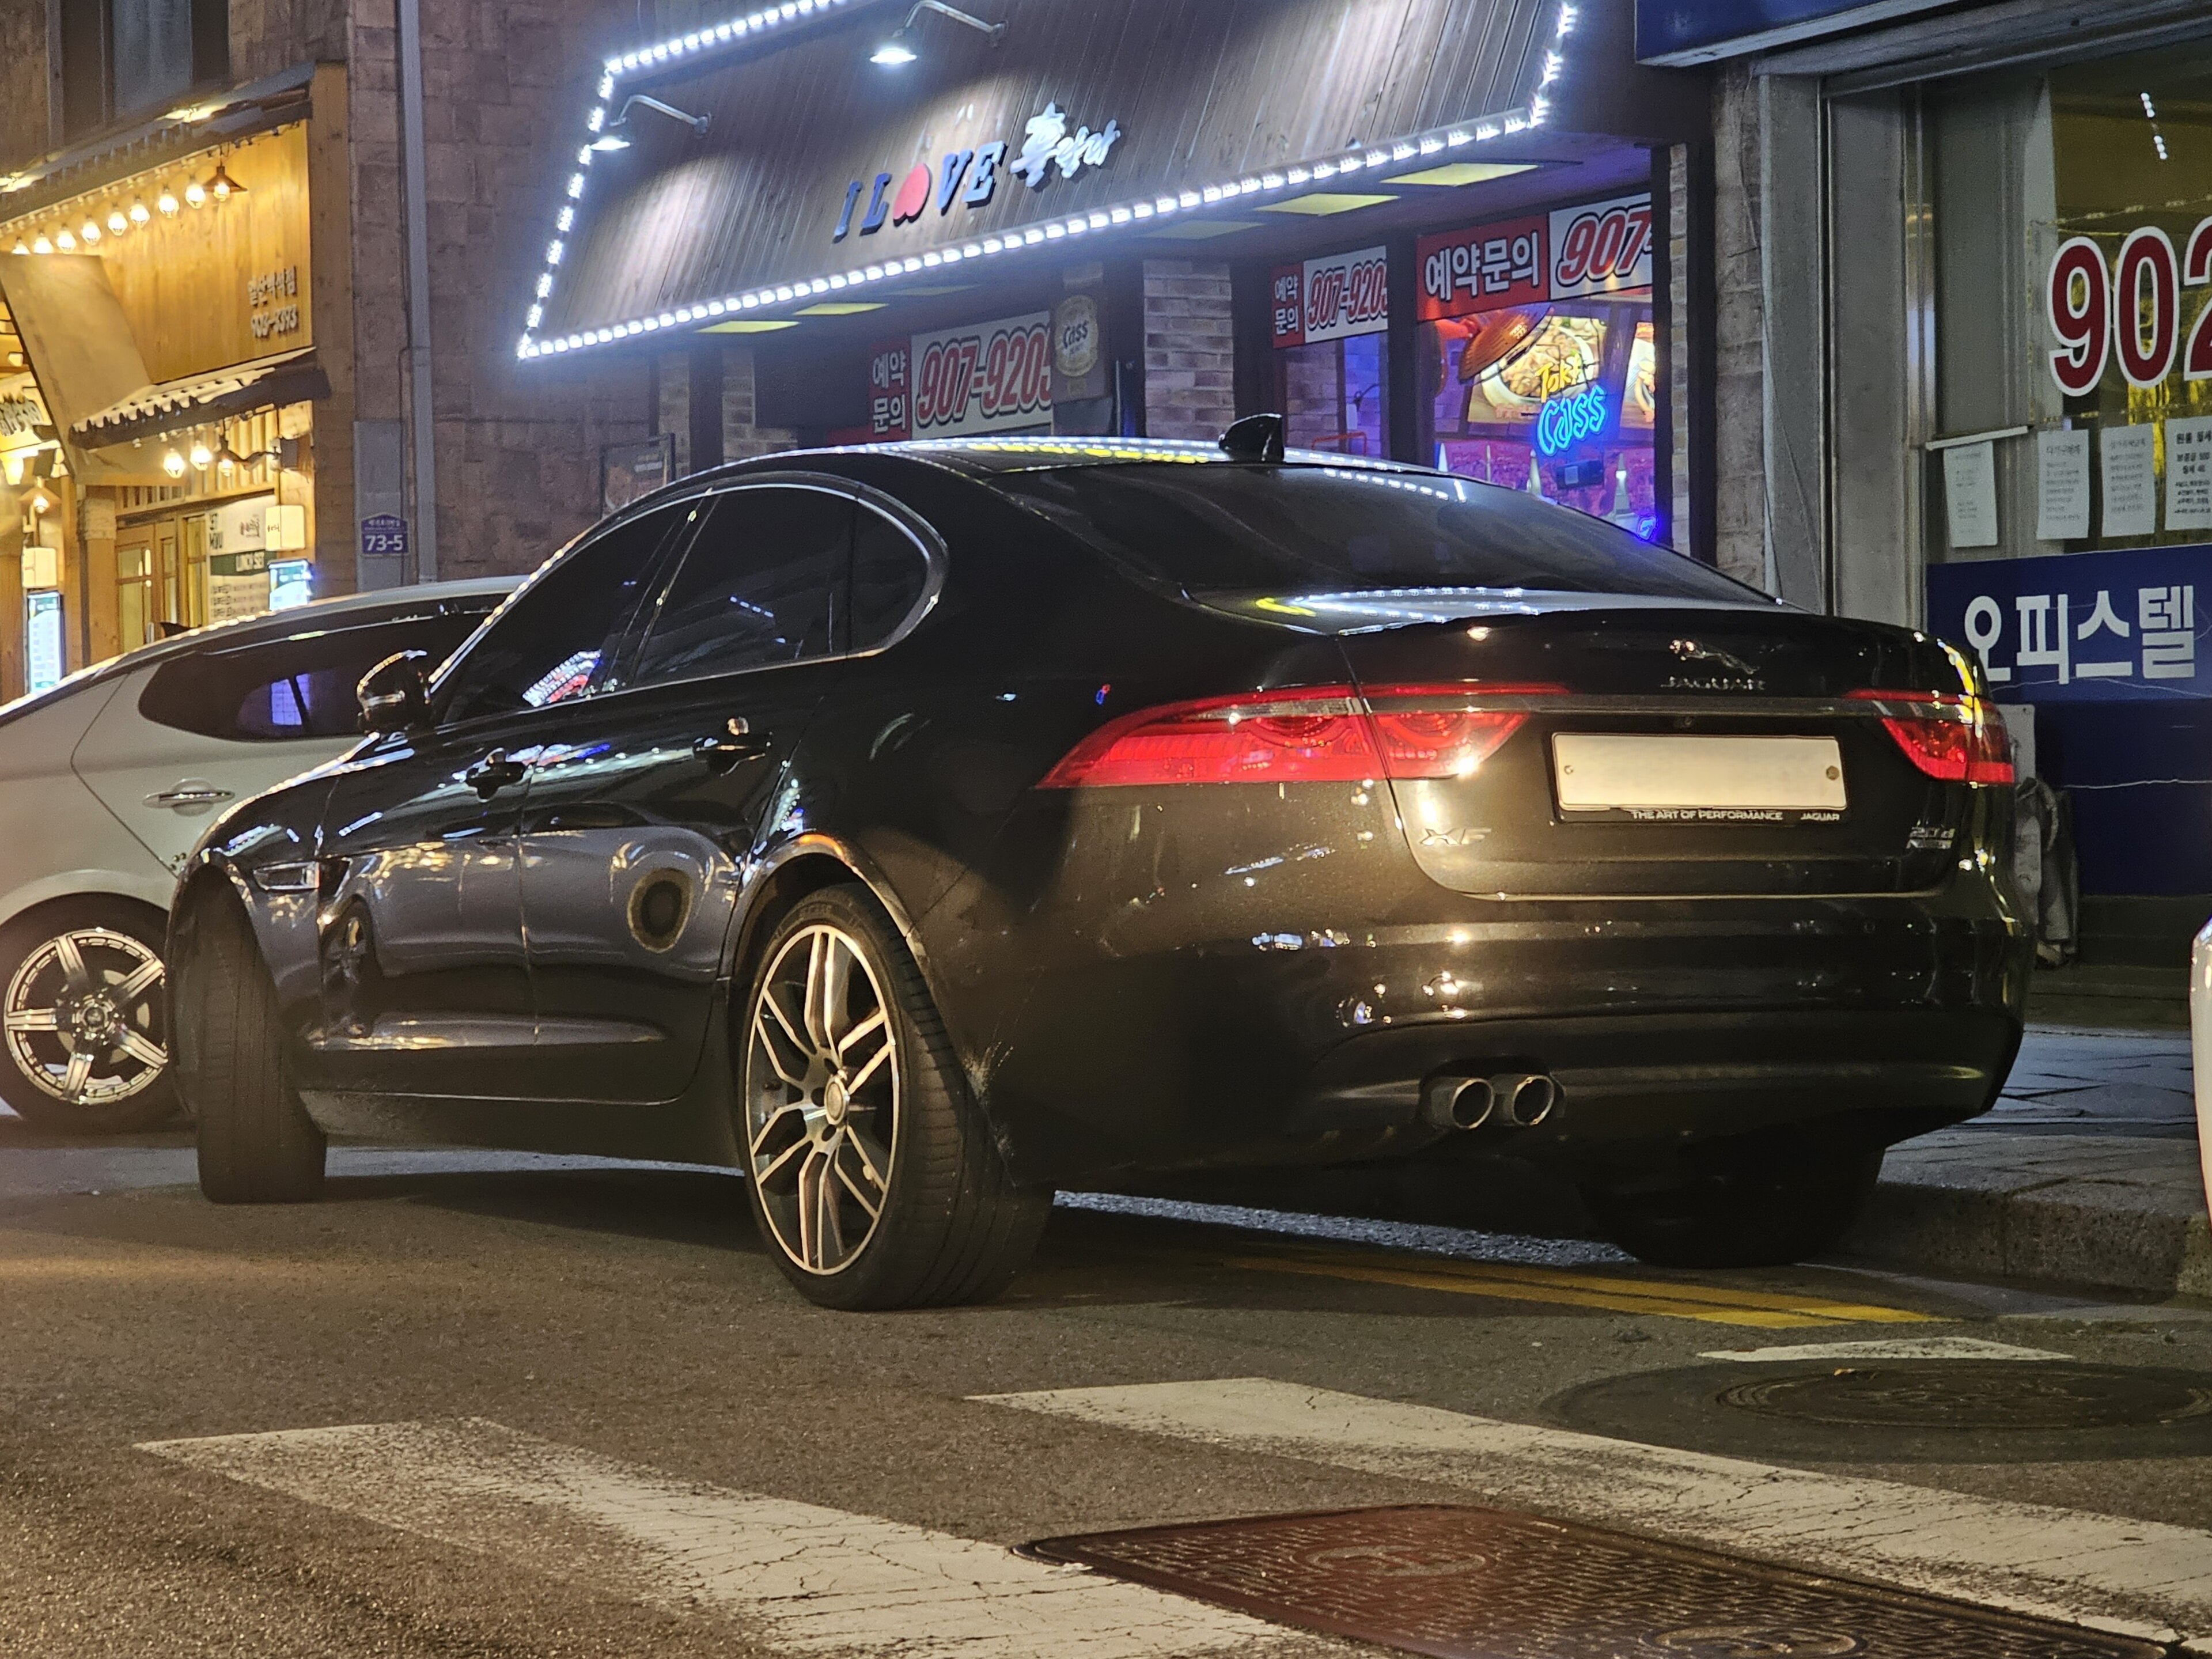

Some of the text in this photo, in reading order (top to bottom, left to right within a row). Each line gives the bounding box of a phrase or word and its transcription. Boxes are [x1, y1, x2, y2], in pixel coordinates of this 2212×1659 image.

[1425, 231, 1540, 302] 예약문의
[1275, 275, 1298, 302] 예약
[1307, 258, 1388, 331] 907-920
[1275, 305, 1298, 335] 문의
[873, 350, 907, 389] 예약
[873, 394, 906, 434] 문의
[365, 534, 403, 551] 73-5
[1964, 585, 2195, 685] 오피스텔
[1632, 810, 1840, 821] THE ART OF PERFORMANCE JAGUAR
